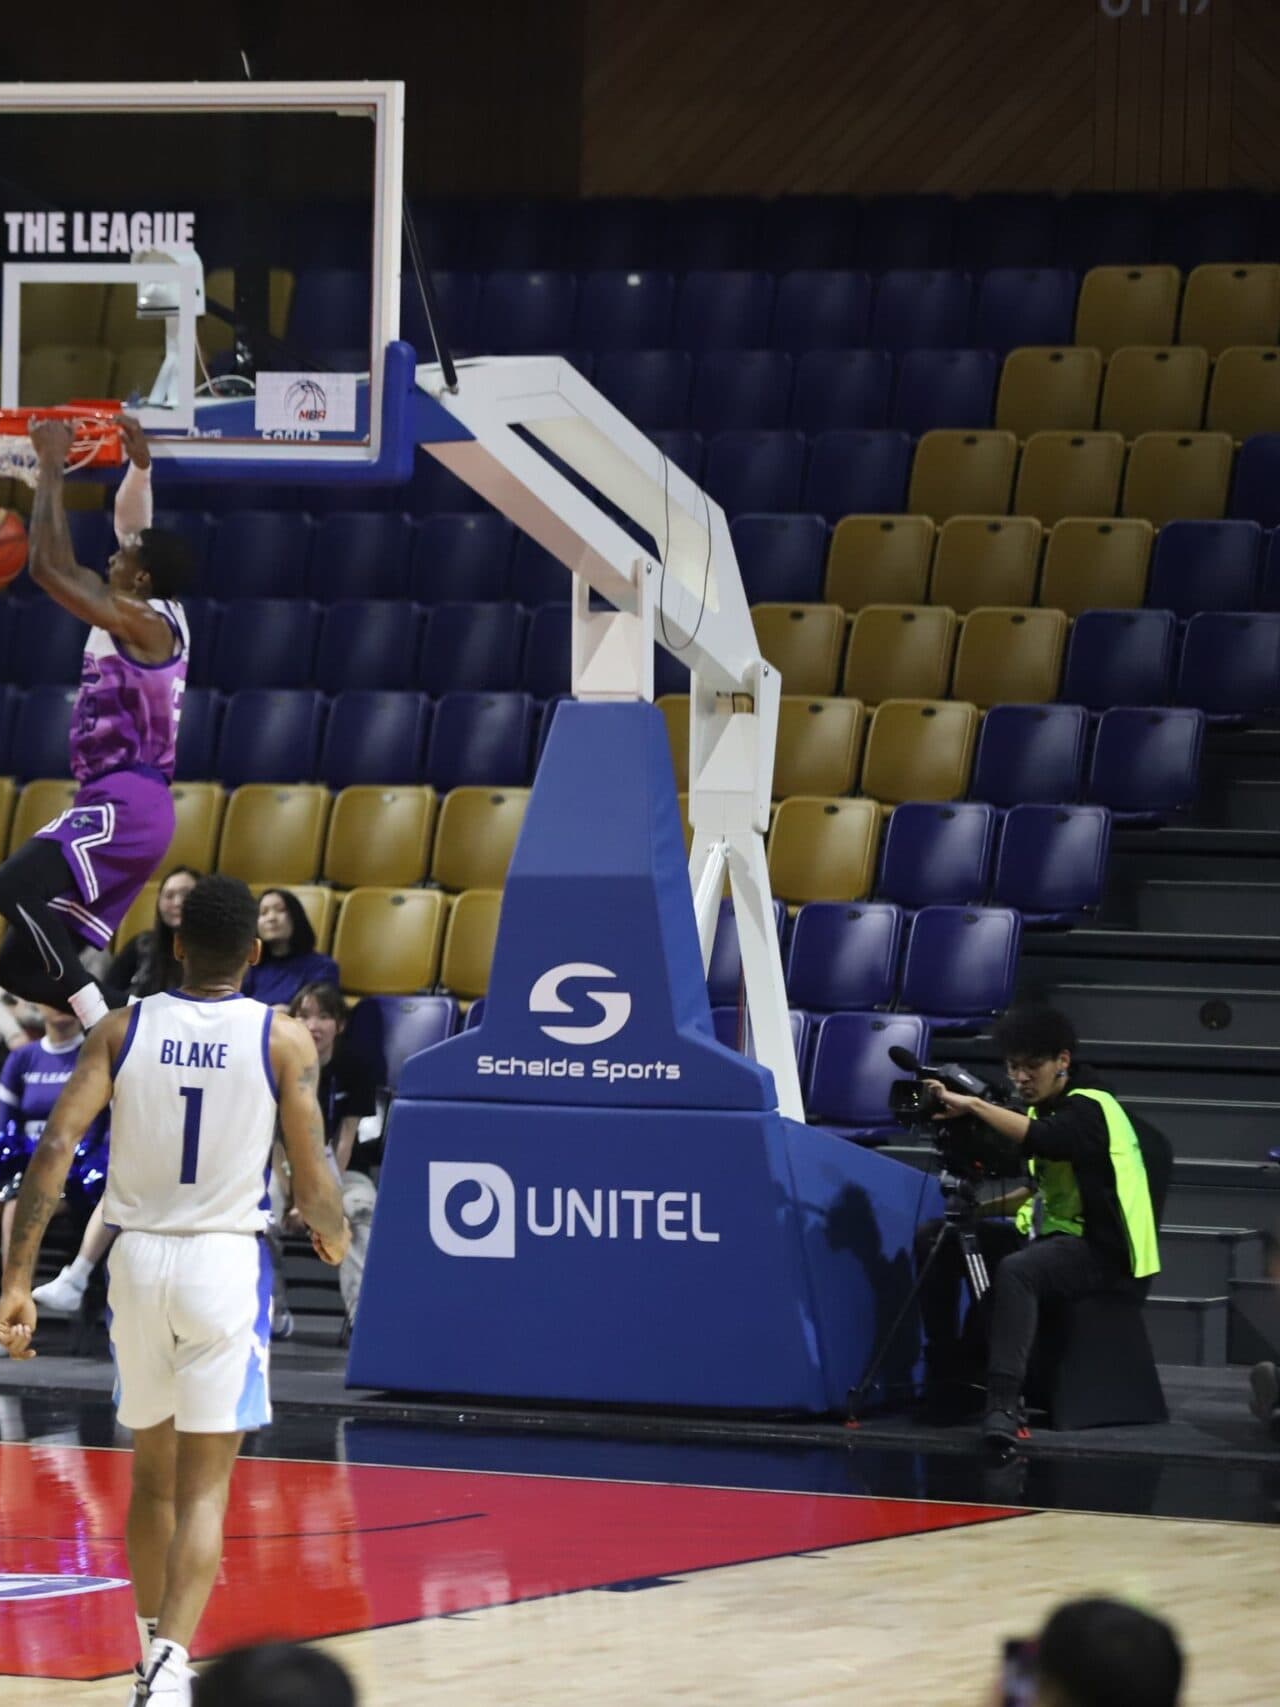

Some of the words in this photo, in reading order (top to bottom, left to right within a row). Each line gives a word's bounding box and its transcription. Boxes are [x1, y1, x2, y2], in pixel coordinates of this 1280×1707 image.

[5, 212, 65, 254] THE
[72, 212, 195, 254] LEAGUE
[160, 1038, 228, 1069] BLAKE
[592, 1058, 681, 1083] Sports
[179, 1086, 204, 1185] 1
[527, 1187, 720, 1243] UNITEL
